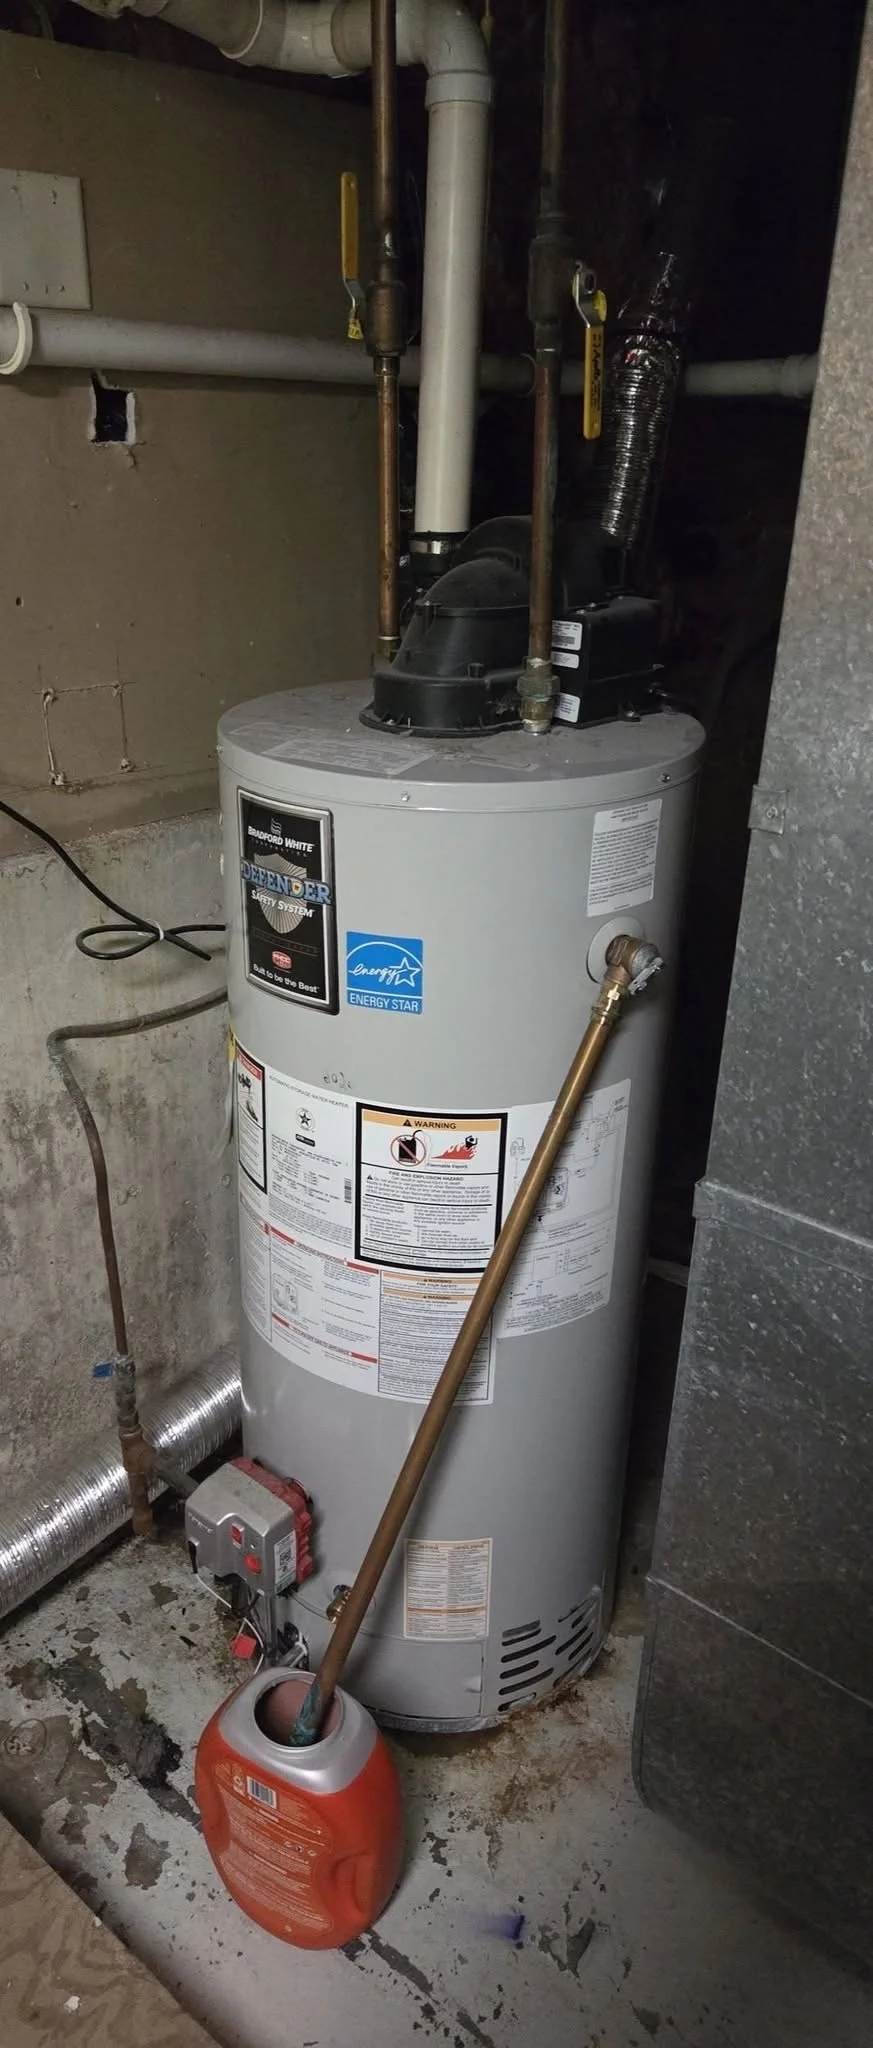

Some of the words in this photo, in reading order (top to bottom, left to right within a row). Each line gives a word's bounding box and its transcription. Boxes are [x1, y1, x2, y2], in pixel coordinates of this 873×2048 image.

[247, 825, 284, 846] BRADFORD
[284, 837, 315, 853] WHITE
[241, 860, 332, 905] DEFENDER
[251, 889, 277, 907] SAFETY
[277, 900, 314, 918] SYSTEM
[253, 963, 266, 976] Built
[266, 970, 274, 979] to
[274, 973, 284, 983] be
[284, 977, 297, 988] the
[298, 981, 319, 993] Best
[352, 963, 399, 985] energy
[350, 992, 390, 1009] ENERGY
[391, 998, 419, 1012] STAR
[414, 1120, 457, 1130] WARNING
